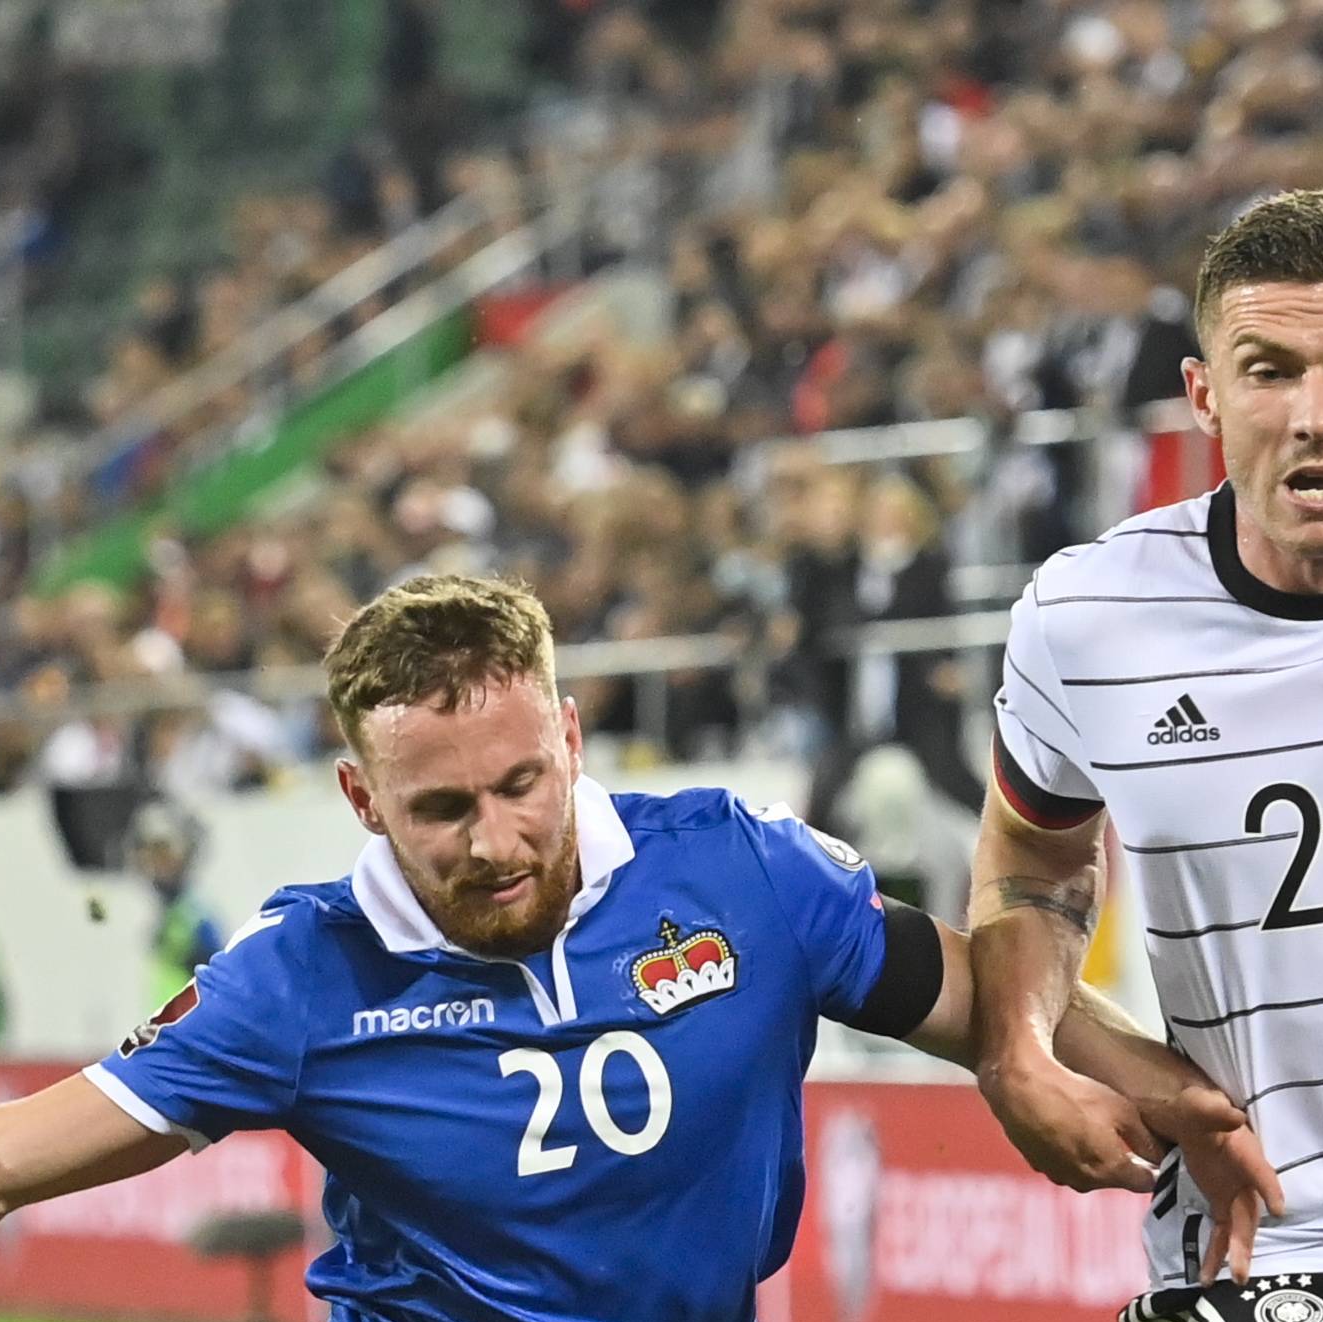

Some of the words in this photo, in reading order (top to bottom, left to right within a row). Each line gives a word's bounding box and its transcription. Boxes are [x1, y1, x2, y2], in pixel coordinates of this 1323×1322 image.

[1146, 724, 1221, 746] adidas
[352, 998, 495, 1036] macron
[497, 1030, 673, 1178] 20
